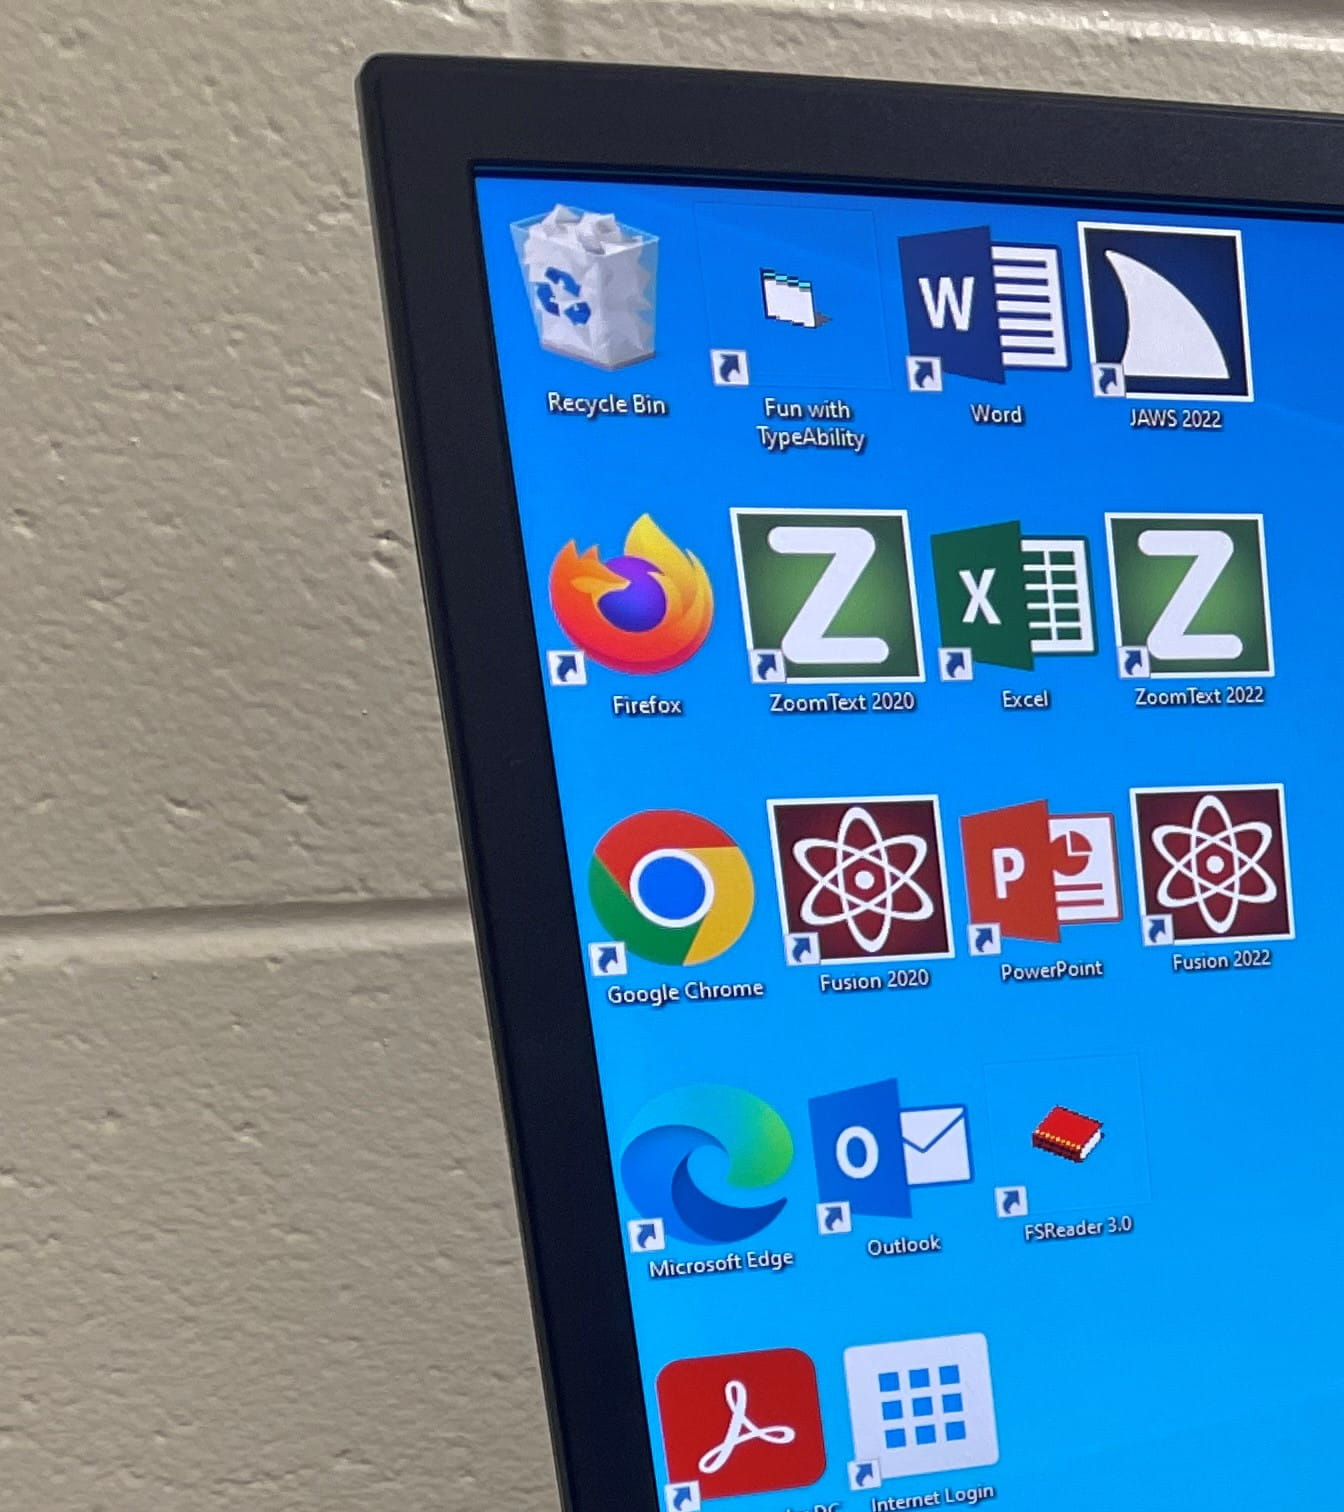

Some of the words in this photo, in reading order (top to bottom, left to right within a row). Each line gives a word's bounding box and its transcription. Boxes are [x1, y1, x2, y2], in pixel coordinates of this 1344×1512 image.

[918, 275, 975, 331] W
[548, 391, 629, 417] Recycle
[632, 395, 667, 415] Bin
[764, 398, 803, 419] Fun
[807, 400, 852, 421] with
[971, 404, 1024, 425] Word
[1128, 407, 1179, 428] JAWS
[1182, 409, 1223, 429] 2022
[756, 425, 866, 452] TypeAbility
[958, 567, 1001, 625] X
[613, 694, 683, 715] Firefox
[770, 692, 866, 713] ZoomText
[871, 691, 916, 711] 2020
[1002, 689, 1049, 709] Excel
[1134, 686, 1221, 707] ZoomText
[1225, 684, 1265, 704] 2022
[993, 848, 1025, 899] P
[1000, 958, 1104, 980] PowerPoint
[1172, 951, 1227, 970] Fusion
[1231, 948, 1272, 968] 2022
[606, 983, 680, 1006] Google
[683, 978, 765, 1000] Chrome
[819, 972, 880, 992] Fusion
[885, 969, 930, 989] 2020
[1024, 1217, 1104, 1241] FSReader
[1107, 1215, 1132, 1235] 3.0
[866, 1233, 942, 1257] Outlook
[648, 1251, 741, 1278] Microsoft
[745, 1248, 795, 1275] Edge
[871, 1491, 941, 1512] Internet
[945, 1484, 995, 1509] Login
